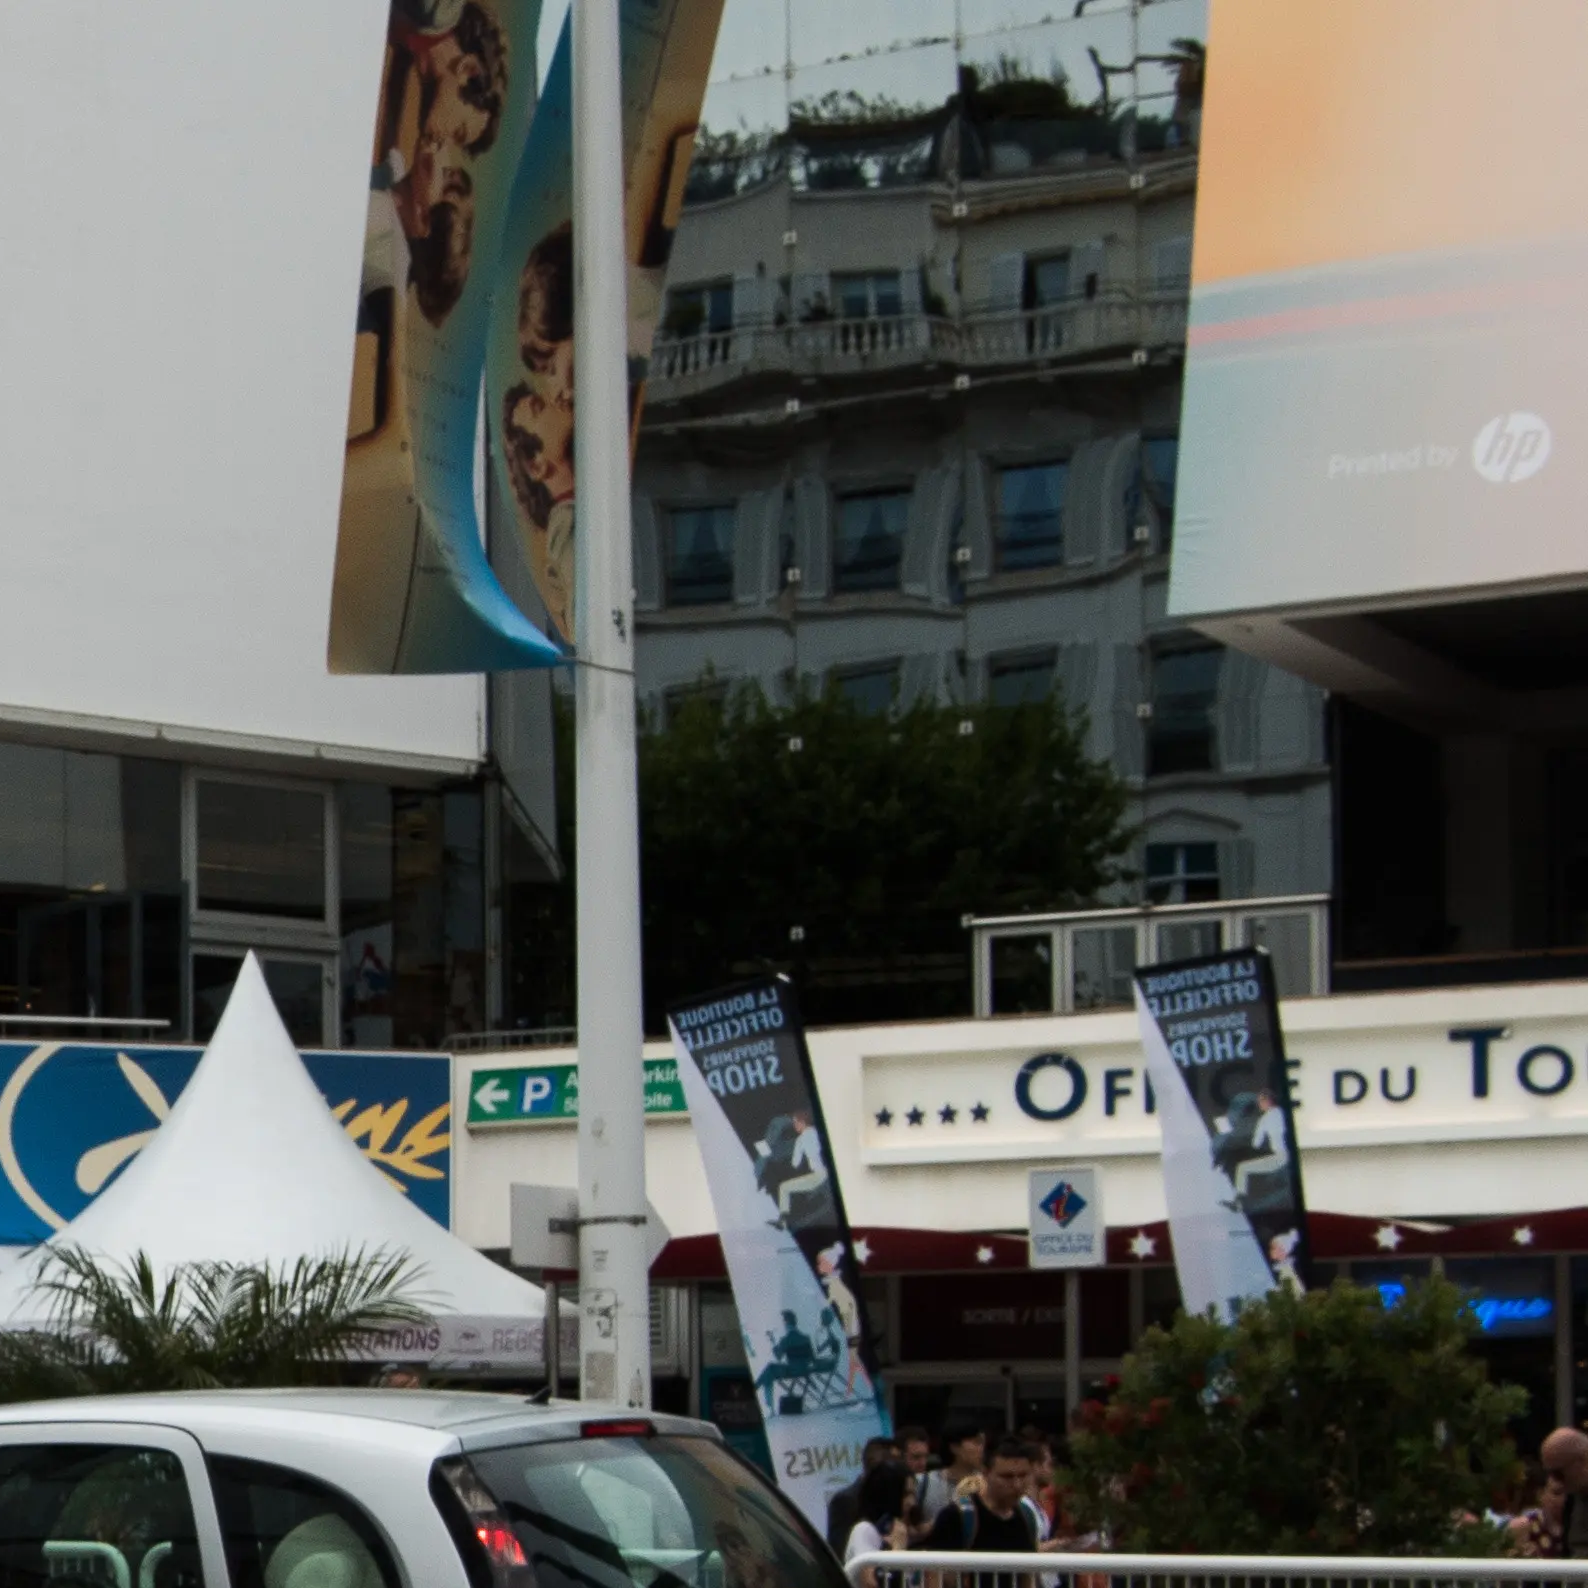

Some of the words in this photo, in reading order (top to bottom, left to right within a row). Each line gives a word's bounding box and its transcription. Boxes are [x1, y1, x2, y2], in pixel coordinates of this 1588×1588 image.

[1327, 446, 1422, 480] Printed
[1425, 444, 1461, 468] by
[1475, 412, 1550, 482] hp
[1334, 1066, 1417, 1107] DU
[1448, 1025, 1588, 1099] TO
